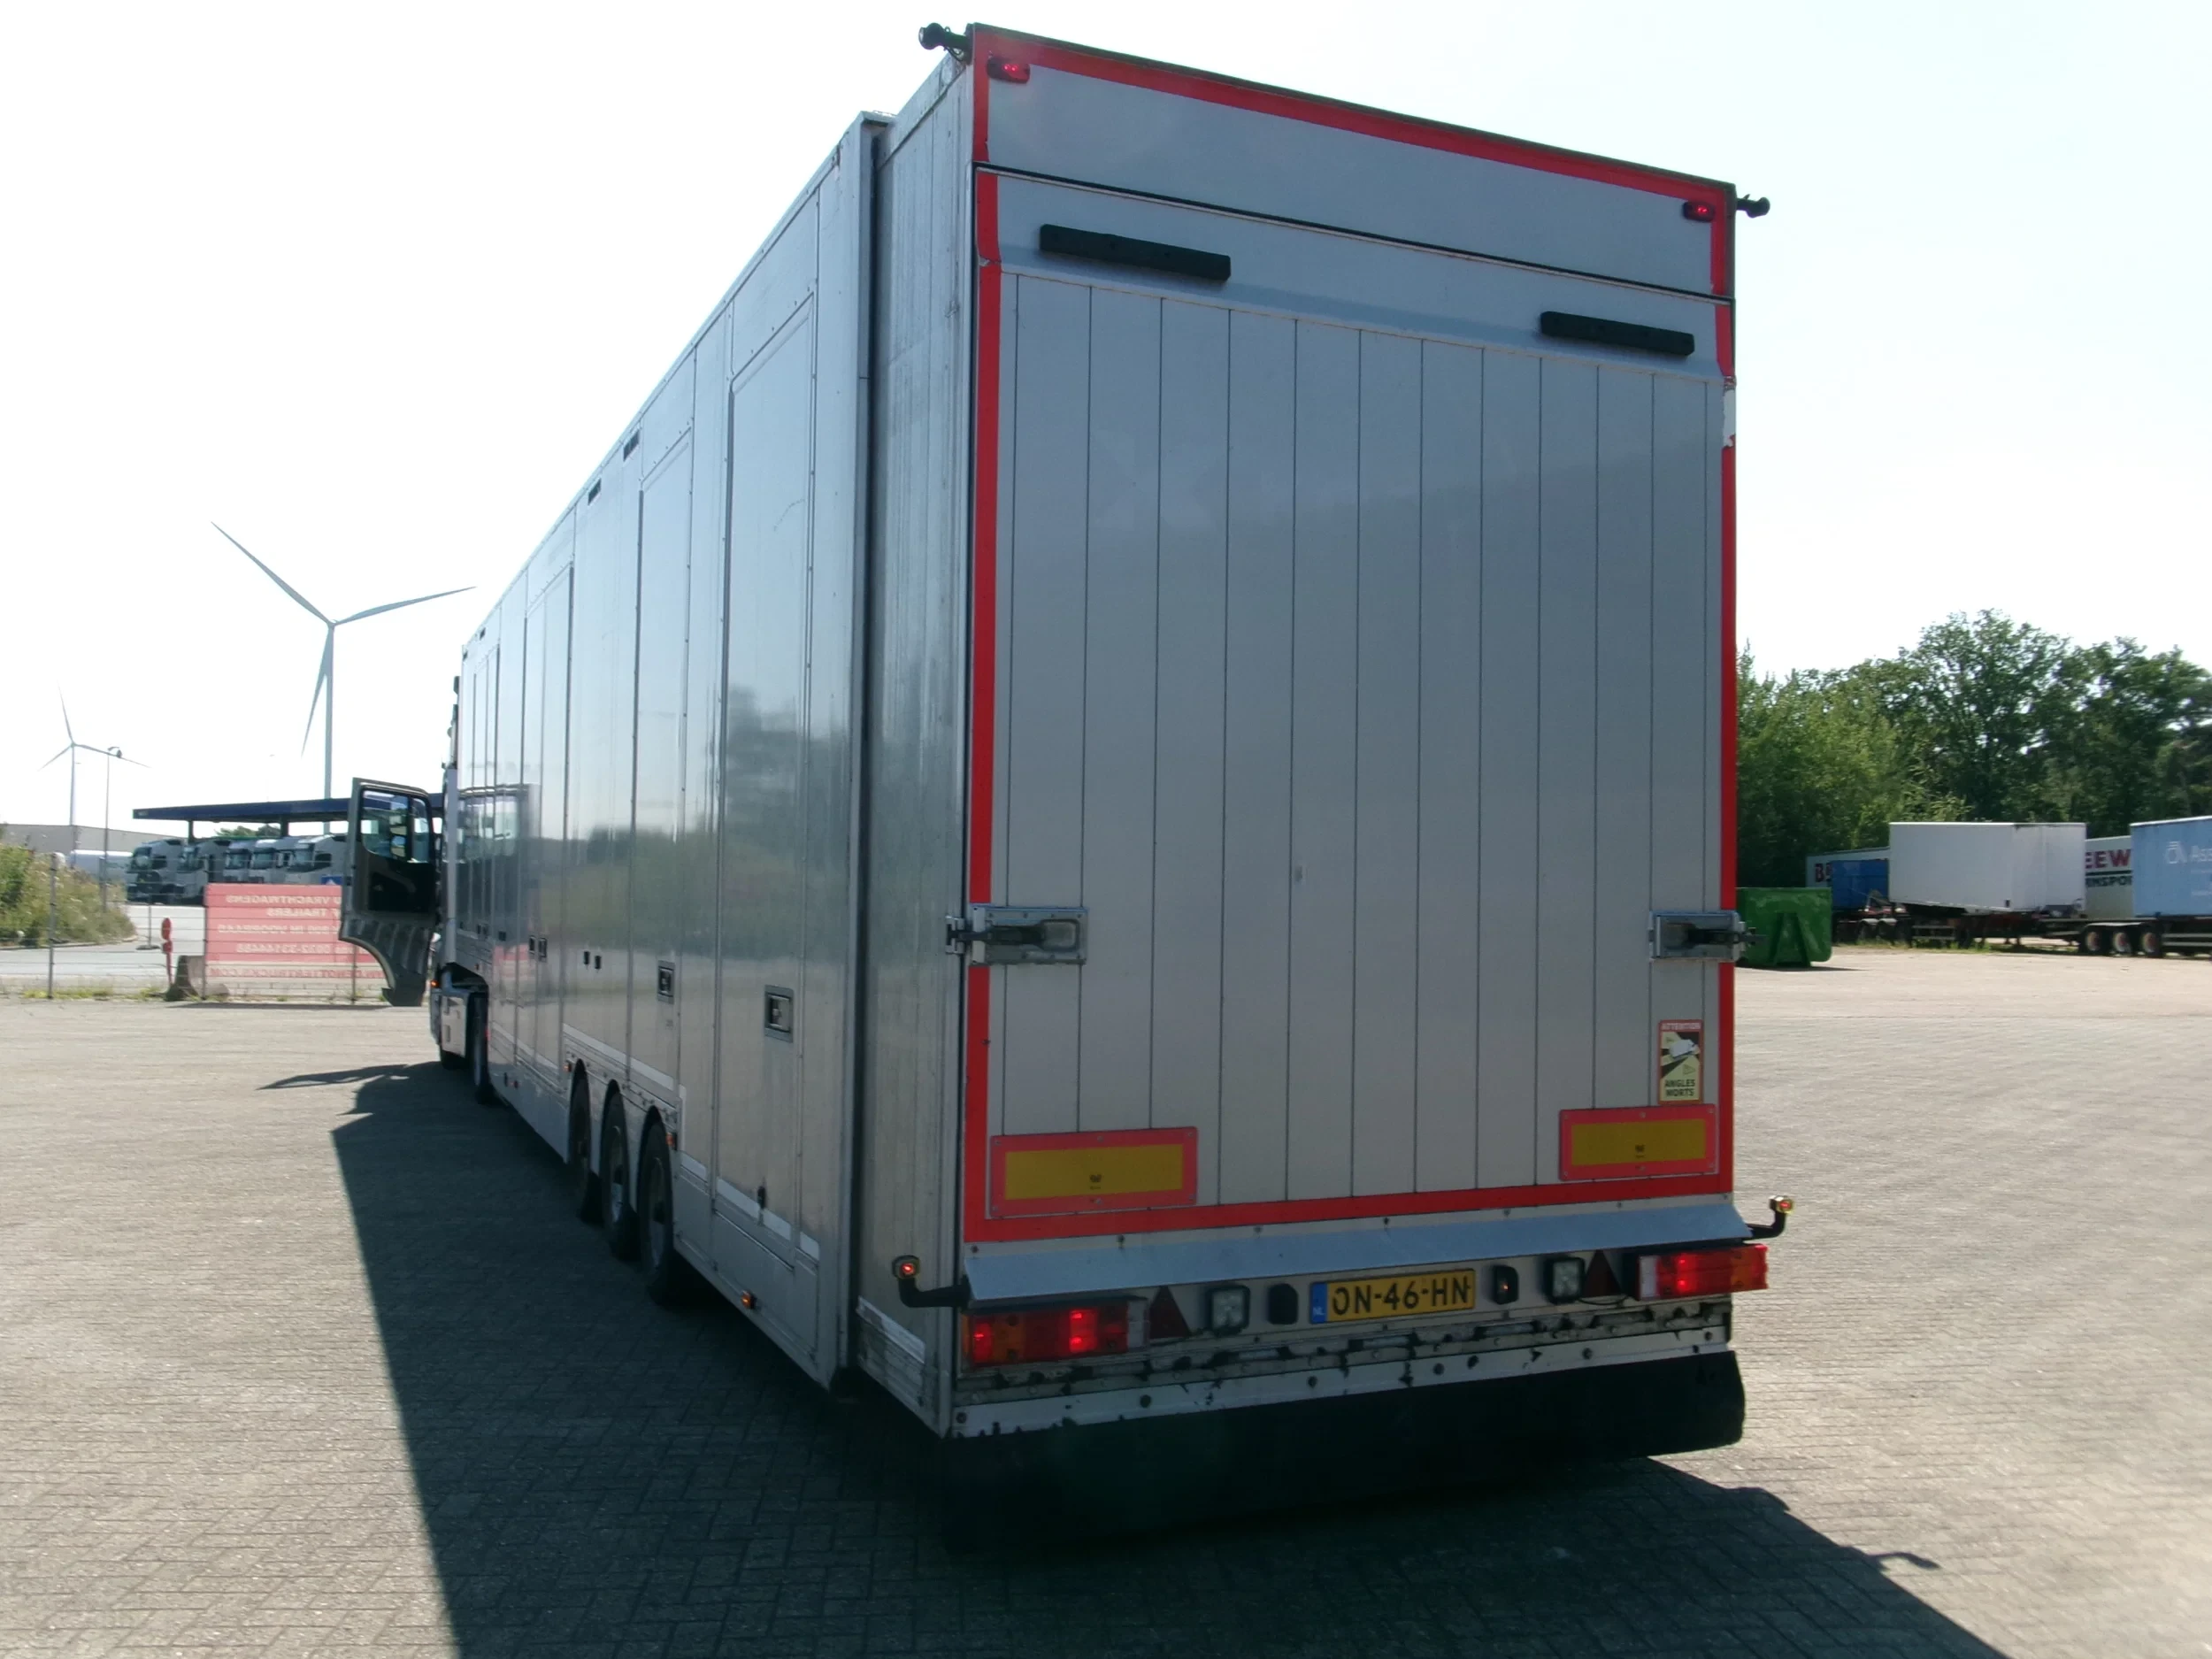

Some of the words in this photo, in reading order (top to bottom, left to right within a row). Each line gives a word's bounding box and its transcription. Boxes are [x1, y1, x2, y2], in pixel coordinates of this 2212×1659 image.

[1665, 1079, 1696, 1087] ANGLES
[1666, 1088, 1694, 1097] MORTS
[1333, 1276, 1471, 1316] ON-46-HN
